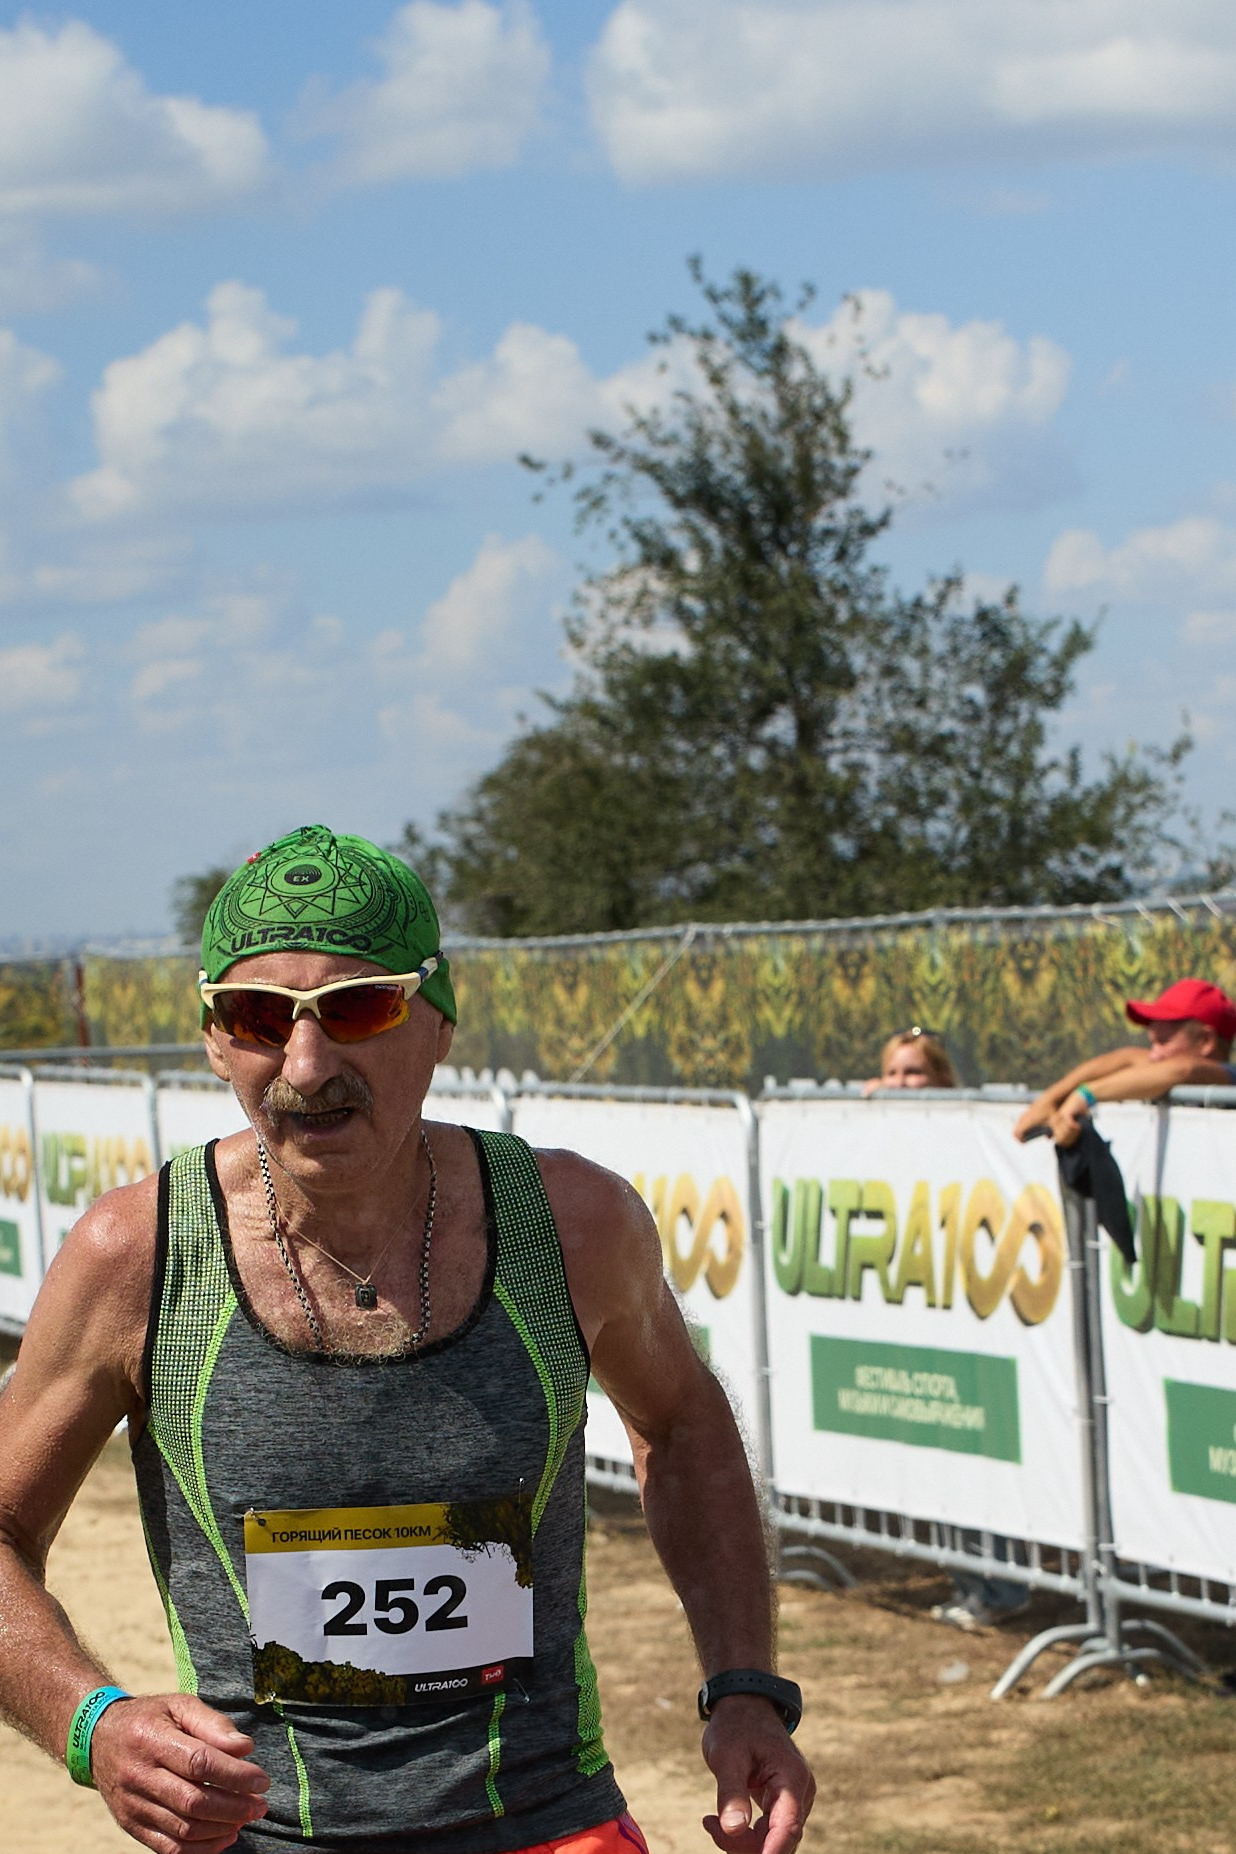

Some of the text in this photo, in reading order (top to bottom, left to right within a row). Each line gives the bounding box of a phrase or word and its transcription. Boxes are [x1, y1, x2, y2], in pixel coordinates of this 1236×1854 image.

[231, 926, 372, 952] ULTRA100
[772, 1177, 1064, 1326] ULTRA100
[1109, 1194, 1236, 1346] ULT
[272, 1526, 342, 1543] ГОРЯЩИЙ
[344, 1526, 393, 1541] ПЕСОК
[320, 1574, 469, 1637] 252
[414, 1677, 469, 1693] ULTRA100
[72, 1691, 106, 1749] ULTRA100
